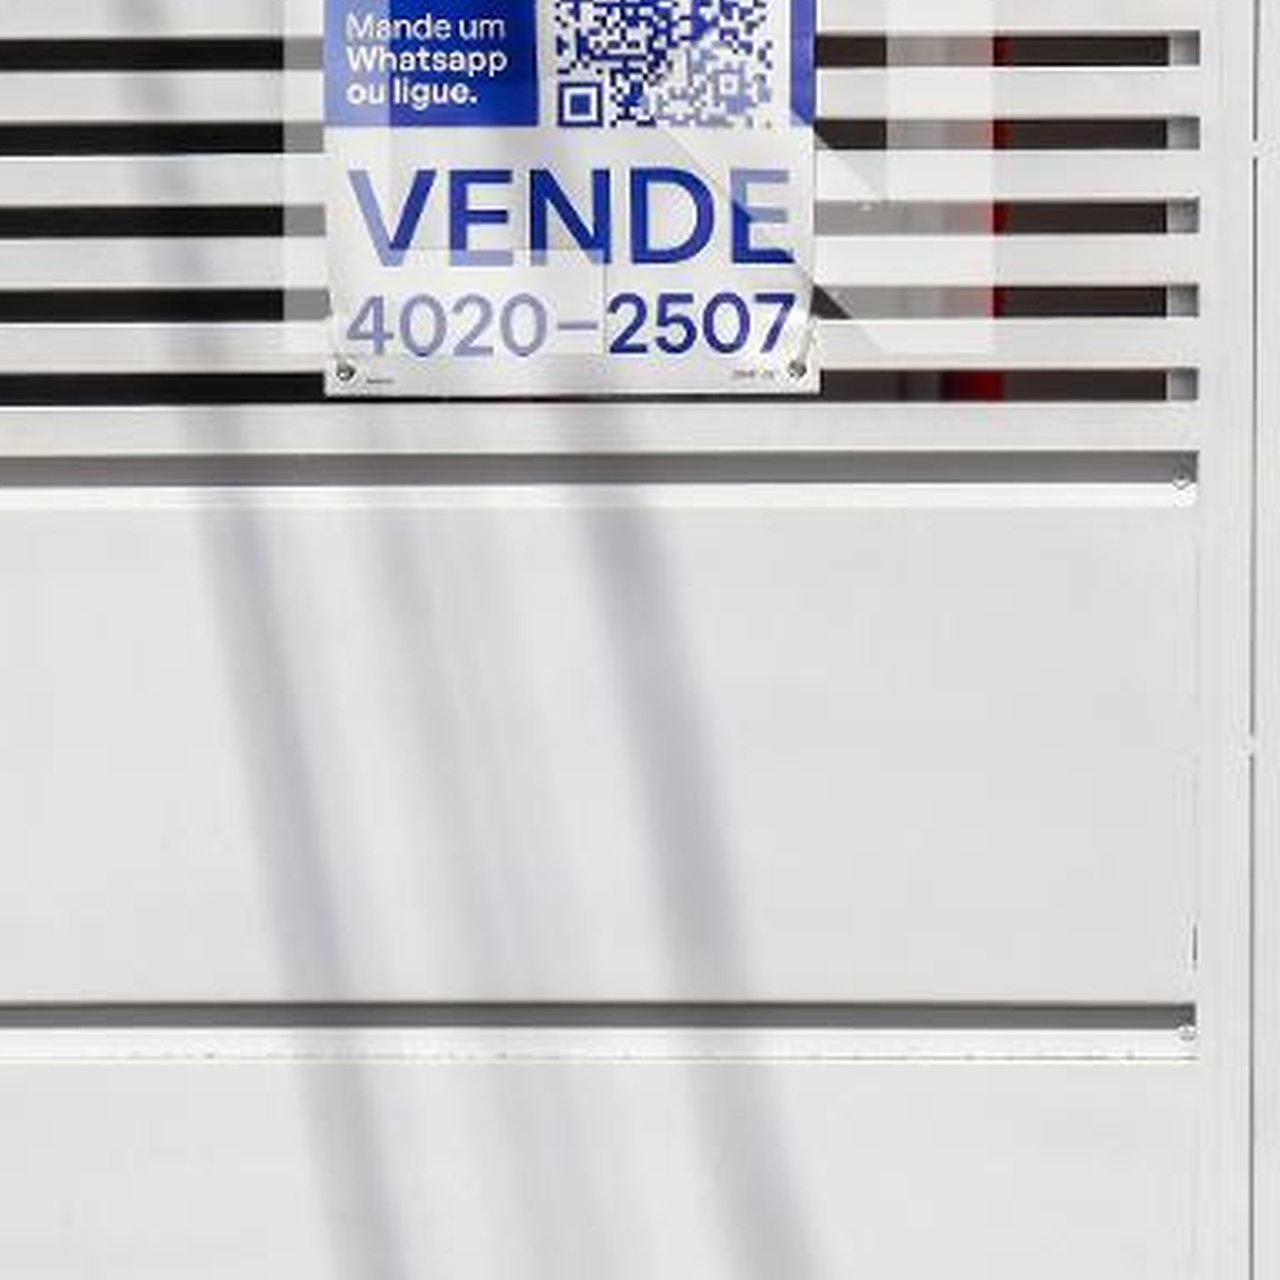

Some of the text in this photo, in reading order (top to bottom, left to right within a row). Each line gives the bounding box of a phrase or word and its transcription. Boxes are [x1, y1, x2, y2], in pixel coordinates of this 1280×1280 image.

[345, 12, 507, 40] Mande um
[345, 45, 508, 78] Whatsapp
[345, 76, 479, 112] ou ligue.
[347, 166, 796, 268] VENDE
[345, 290, 797, 359] 4020-2507
